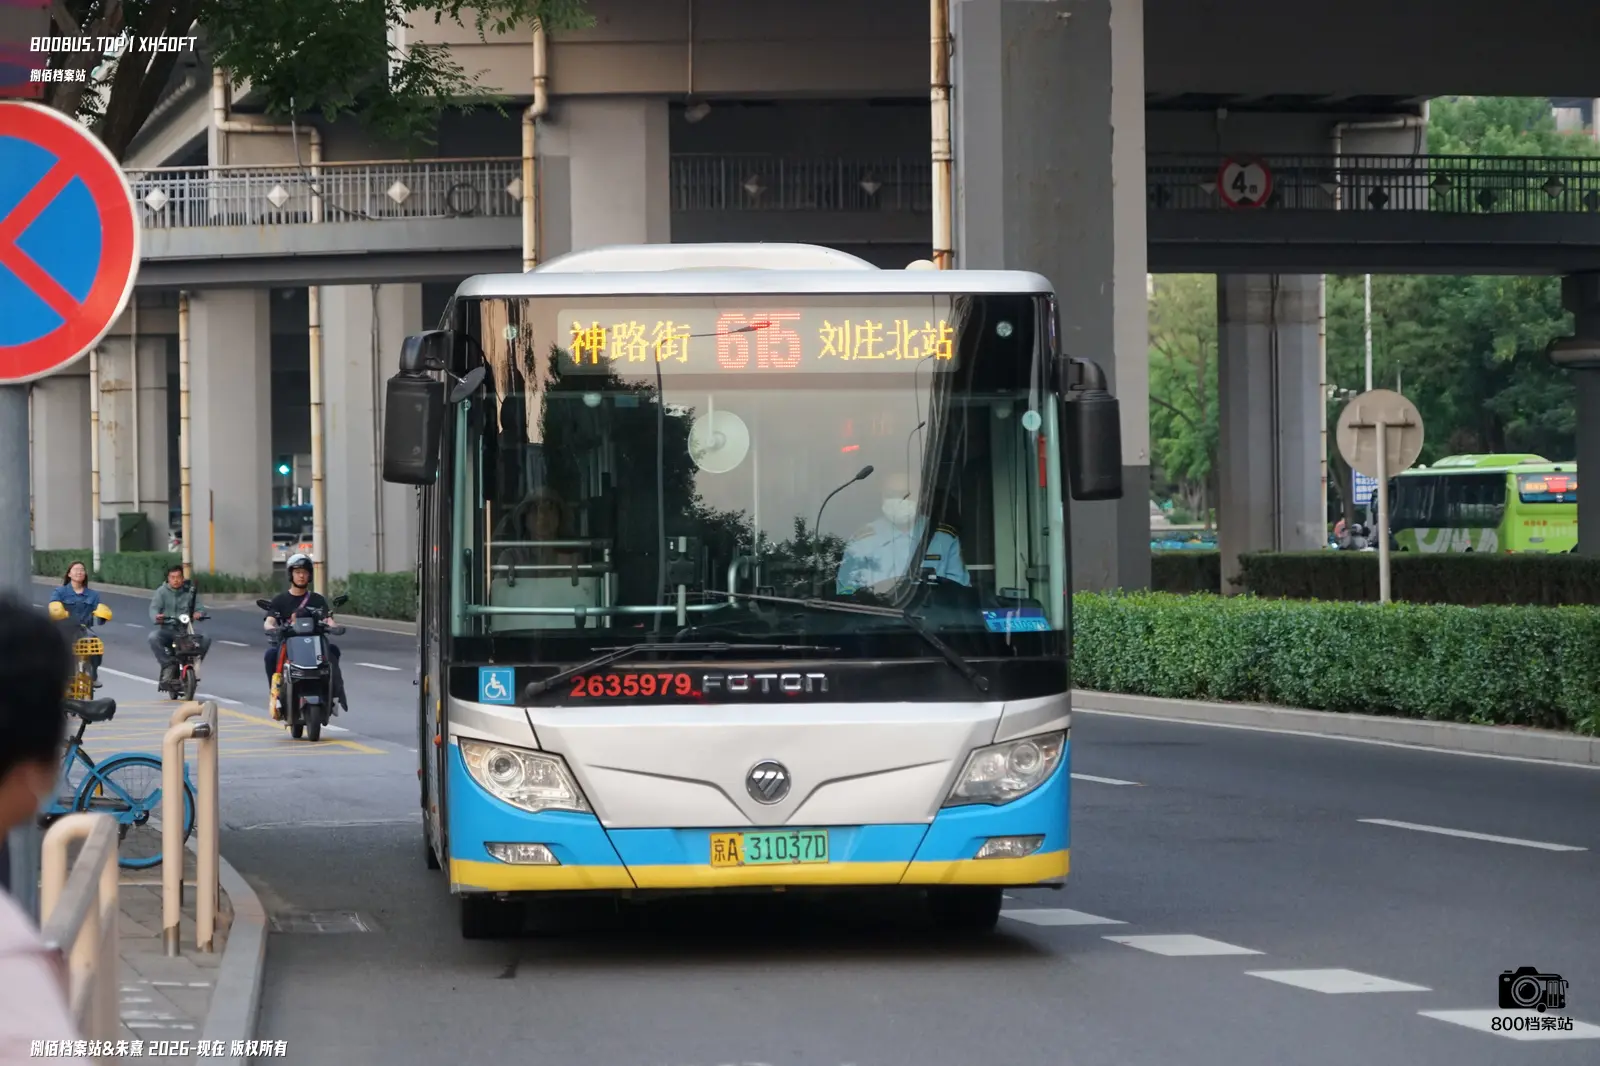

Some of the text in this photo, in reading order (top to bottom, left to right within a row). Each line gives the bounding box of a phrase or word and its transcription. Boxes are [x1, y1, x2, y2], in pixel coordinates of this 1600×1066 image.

[568, 311, 954, 369] 神路街 615 刘庄北站
[570, 672, 828, 697] 2635979 FOTON
